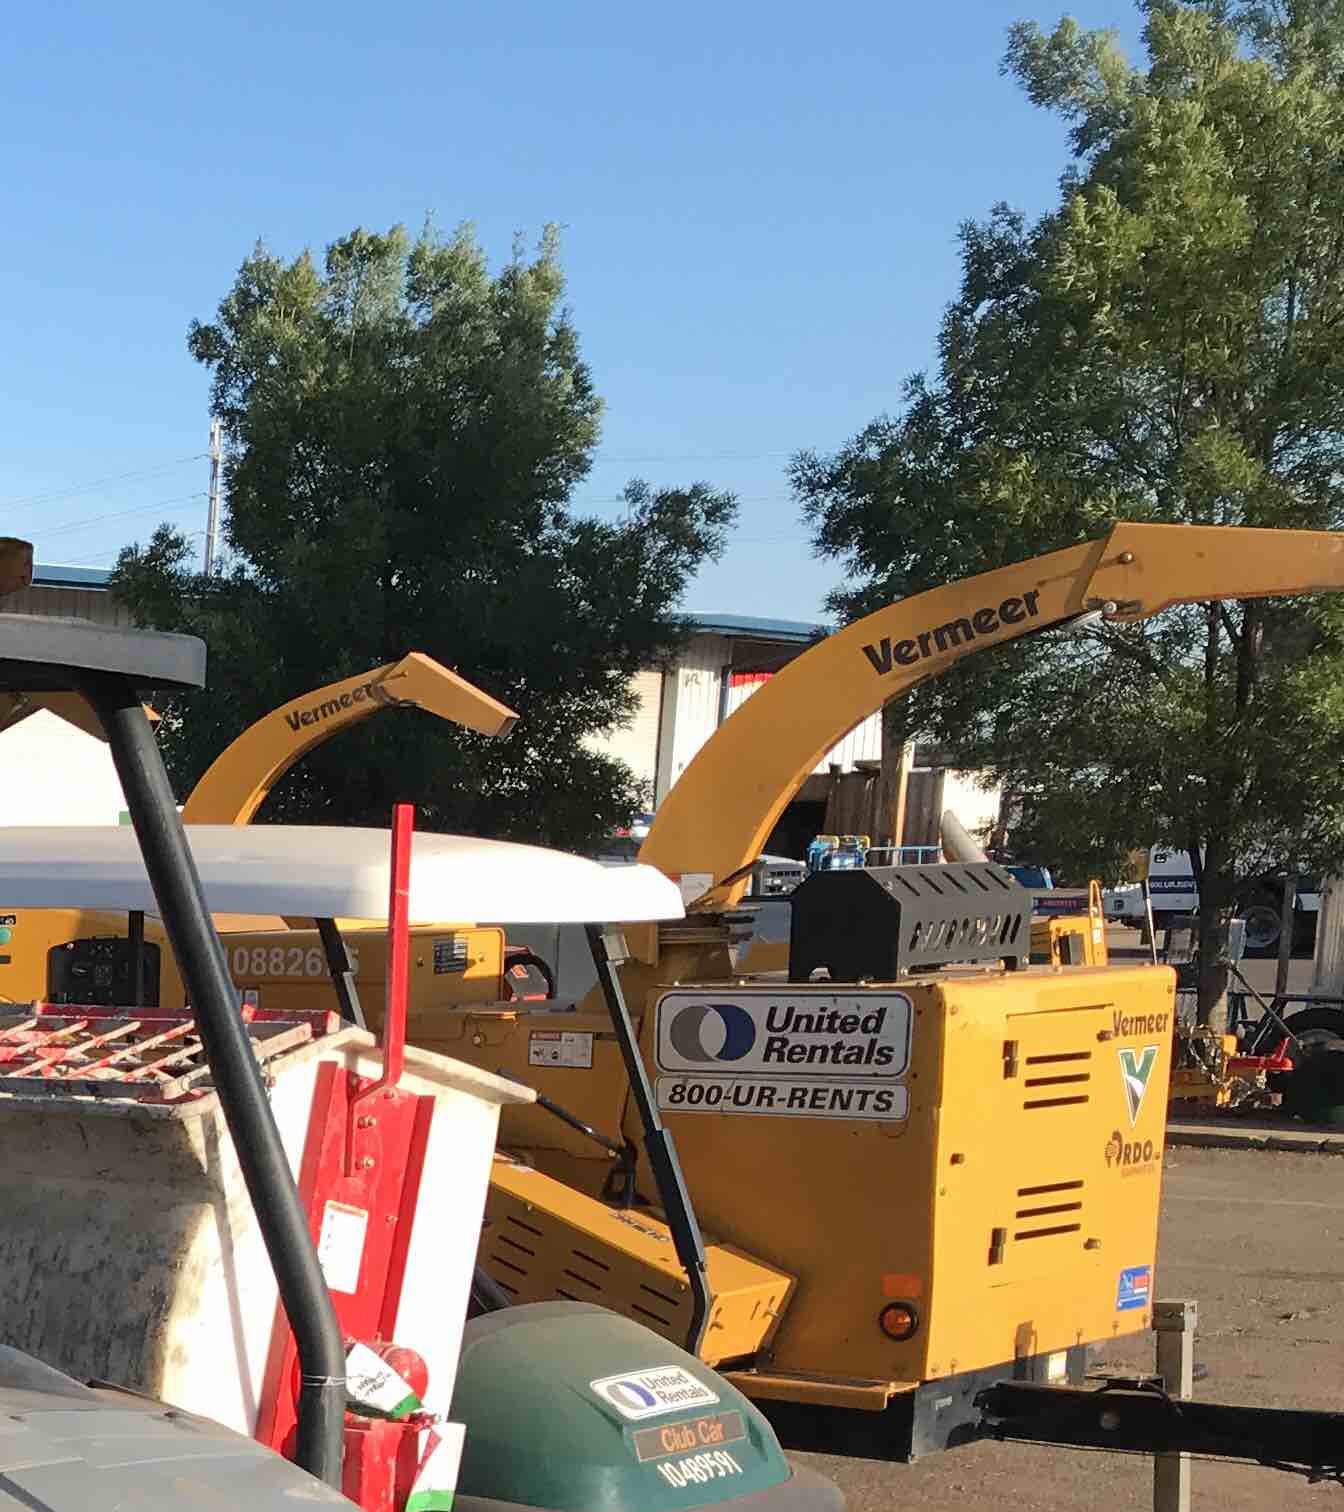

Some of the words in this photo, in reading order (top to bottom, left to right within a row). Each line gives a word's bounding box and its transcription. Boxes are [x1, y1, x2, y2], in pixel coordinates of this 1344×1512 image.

[862, 589, 1040, 675] Vermeer
[287, 683, 374, 730] Vermeer
[765, 1006, 888, 1035] United
[1112, 1010, 1169, 1038] Vermeer
[762, 1037, 895, 1066] Rentals
[668, 1083, 895, 1113] 800-UR-RENTS
[640, 1372, 689, 1390] United
[657, 1385, 710, 1406] Rentals
[660, 1424, 696, 1451] Club
[697, 1420, 725, 1445] Car
